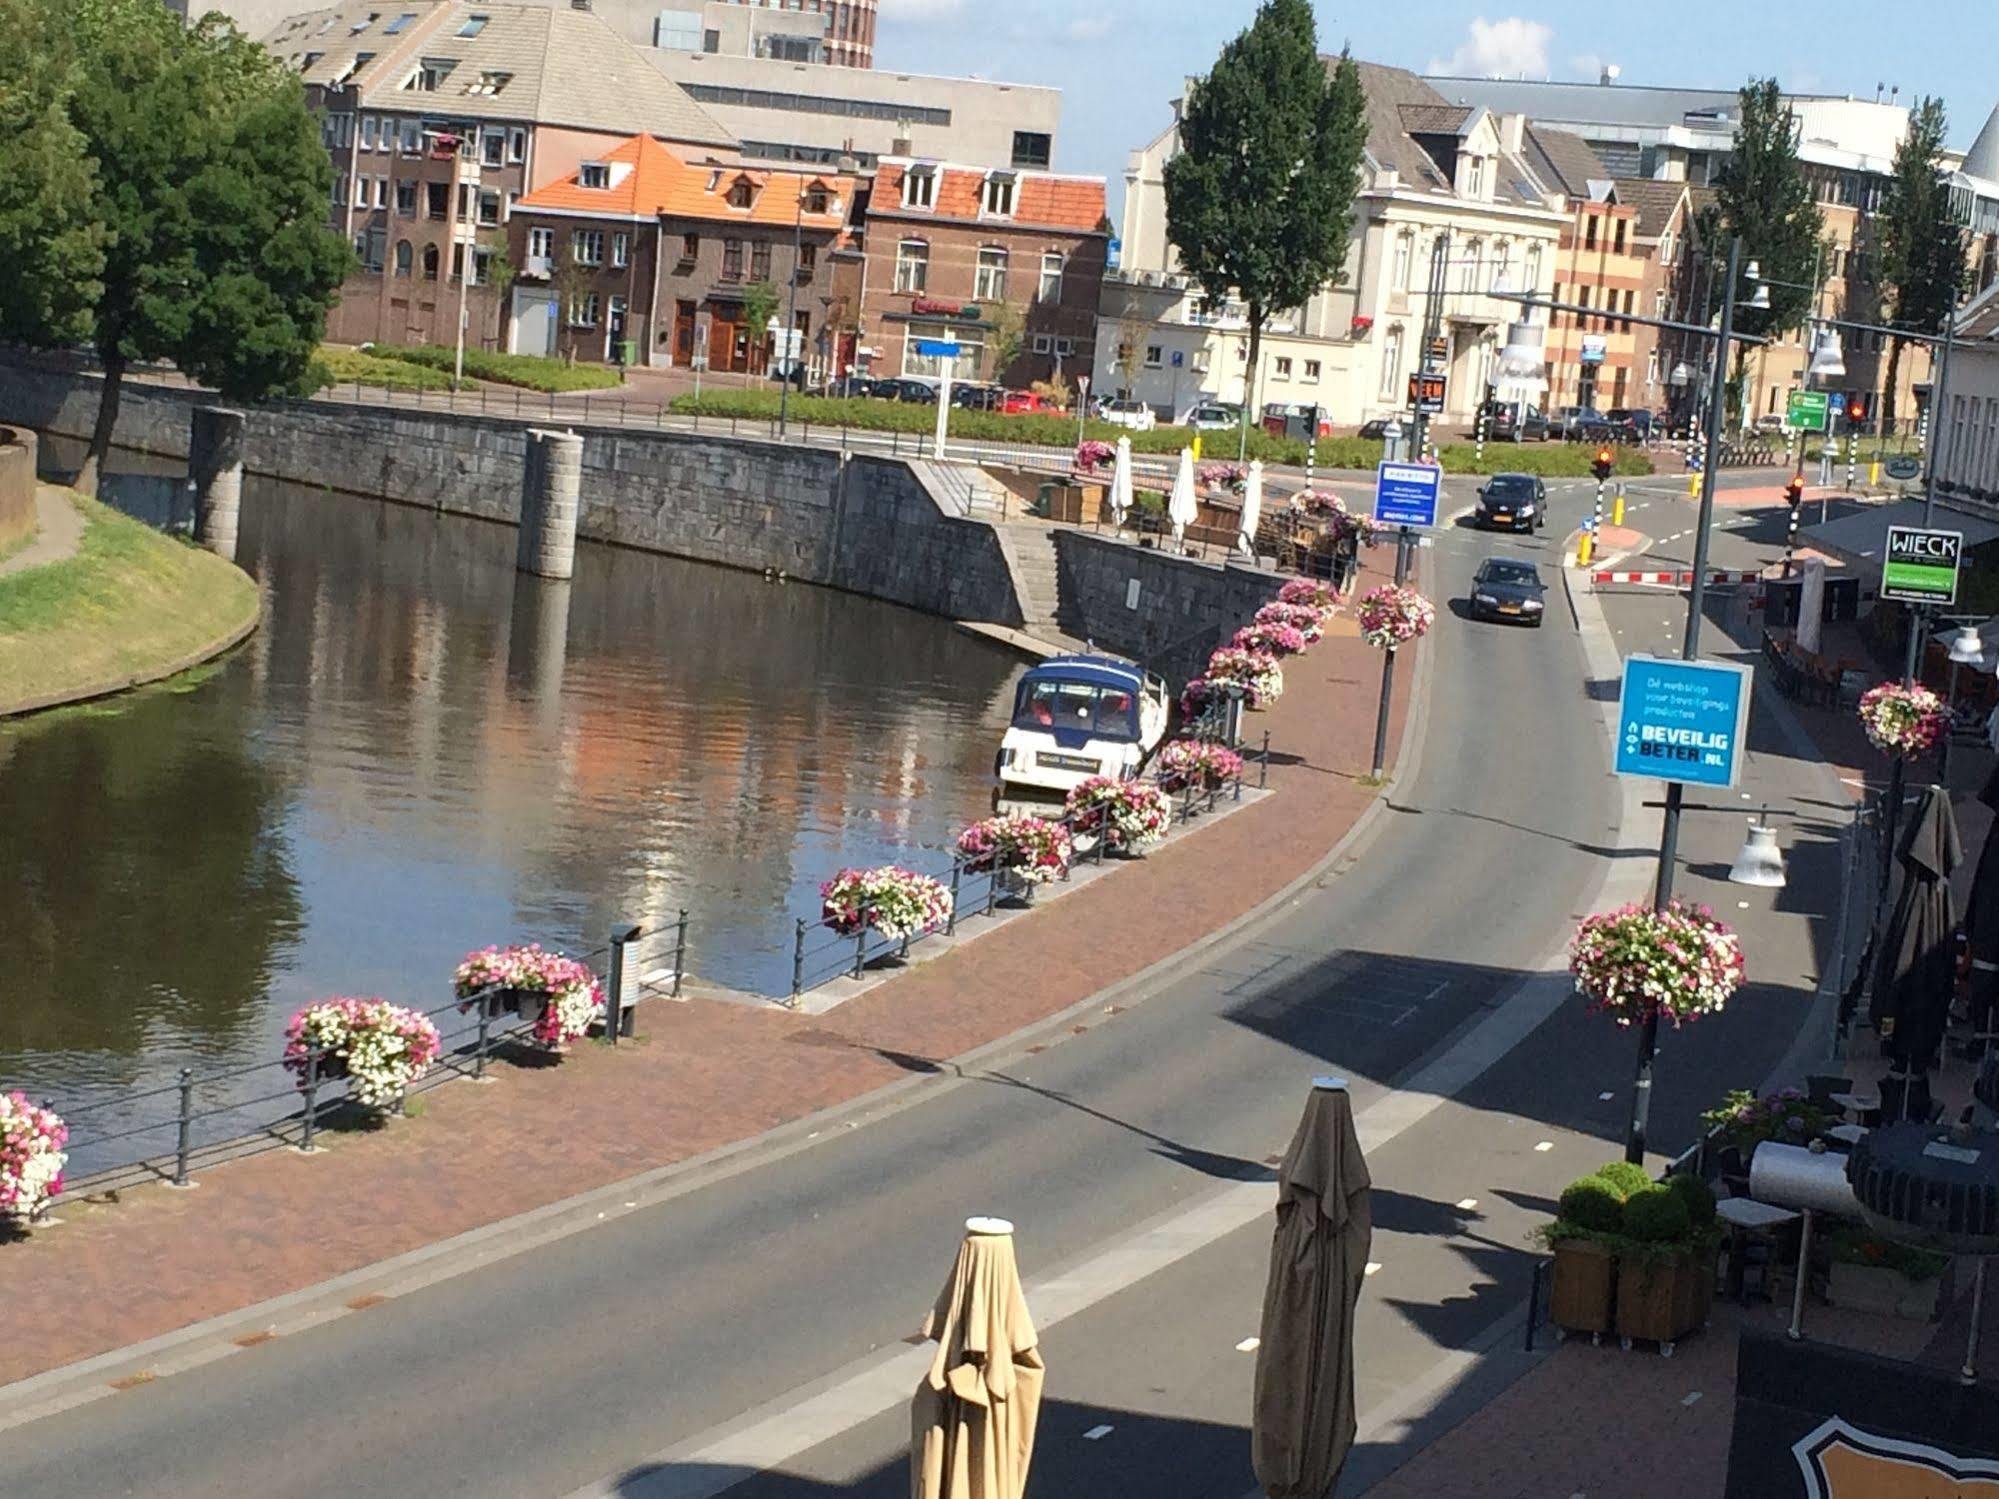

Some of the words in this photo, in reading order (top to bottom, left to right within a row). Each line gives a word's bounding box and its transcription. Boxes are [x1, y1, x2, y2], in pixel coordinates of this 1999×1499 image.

[1892, 533, 1956, 557] WIECK
[1645, 694, 1669, 702] voor
[1663, 681, 1709, 696] webshop
[1641, 725, 1728, 750] BEVEILIG
